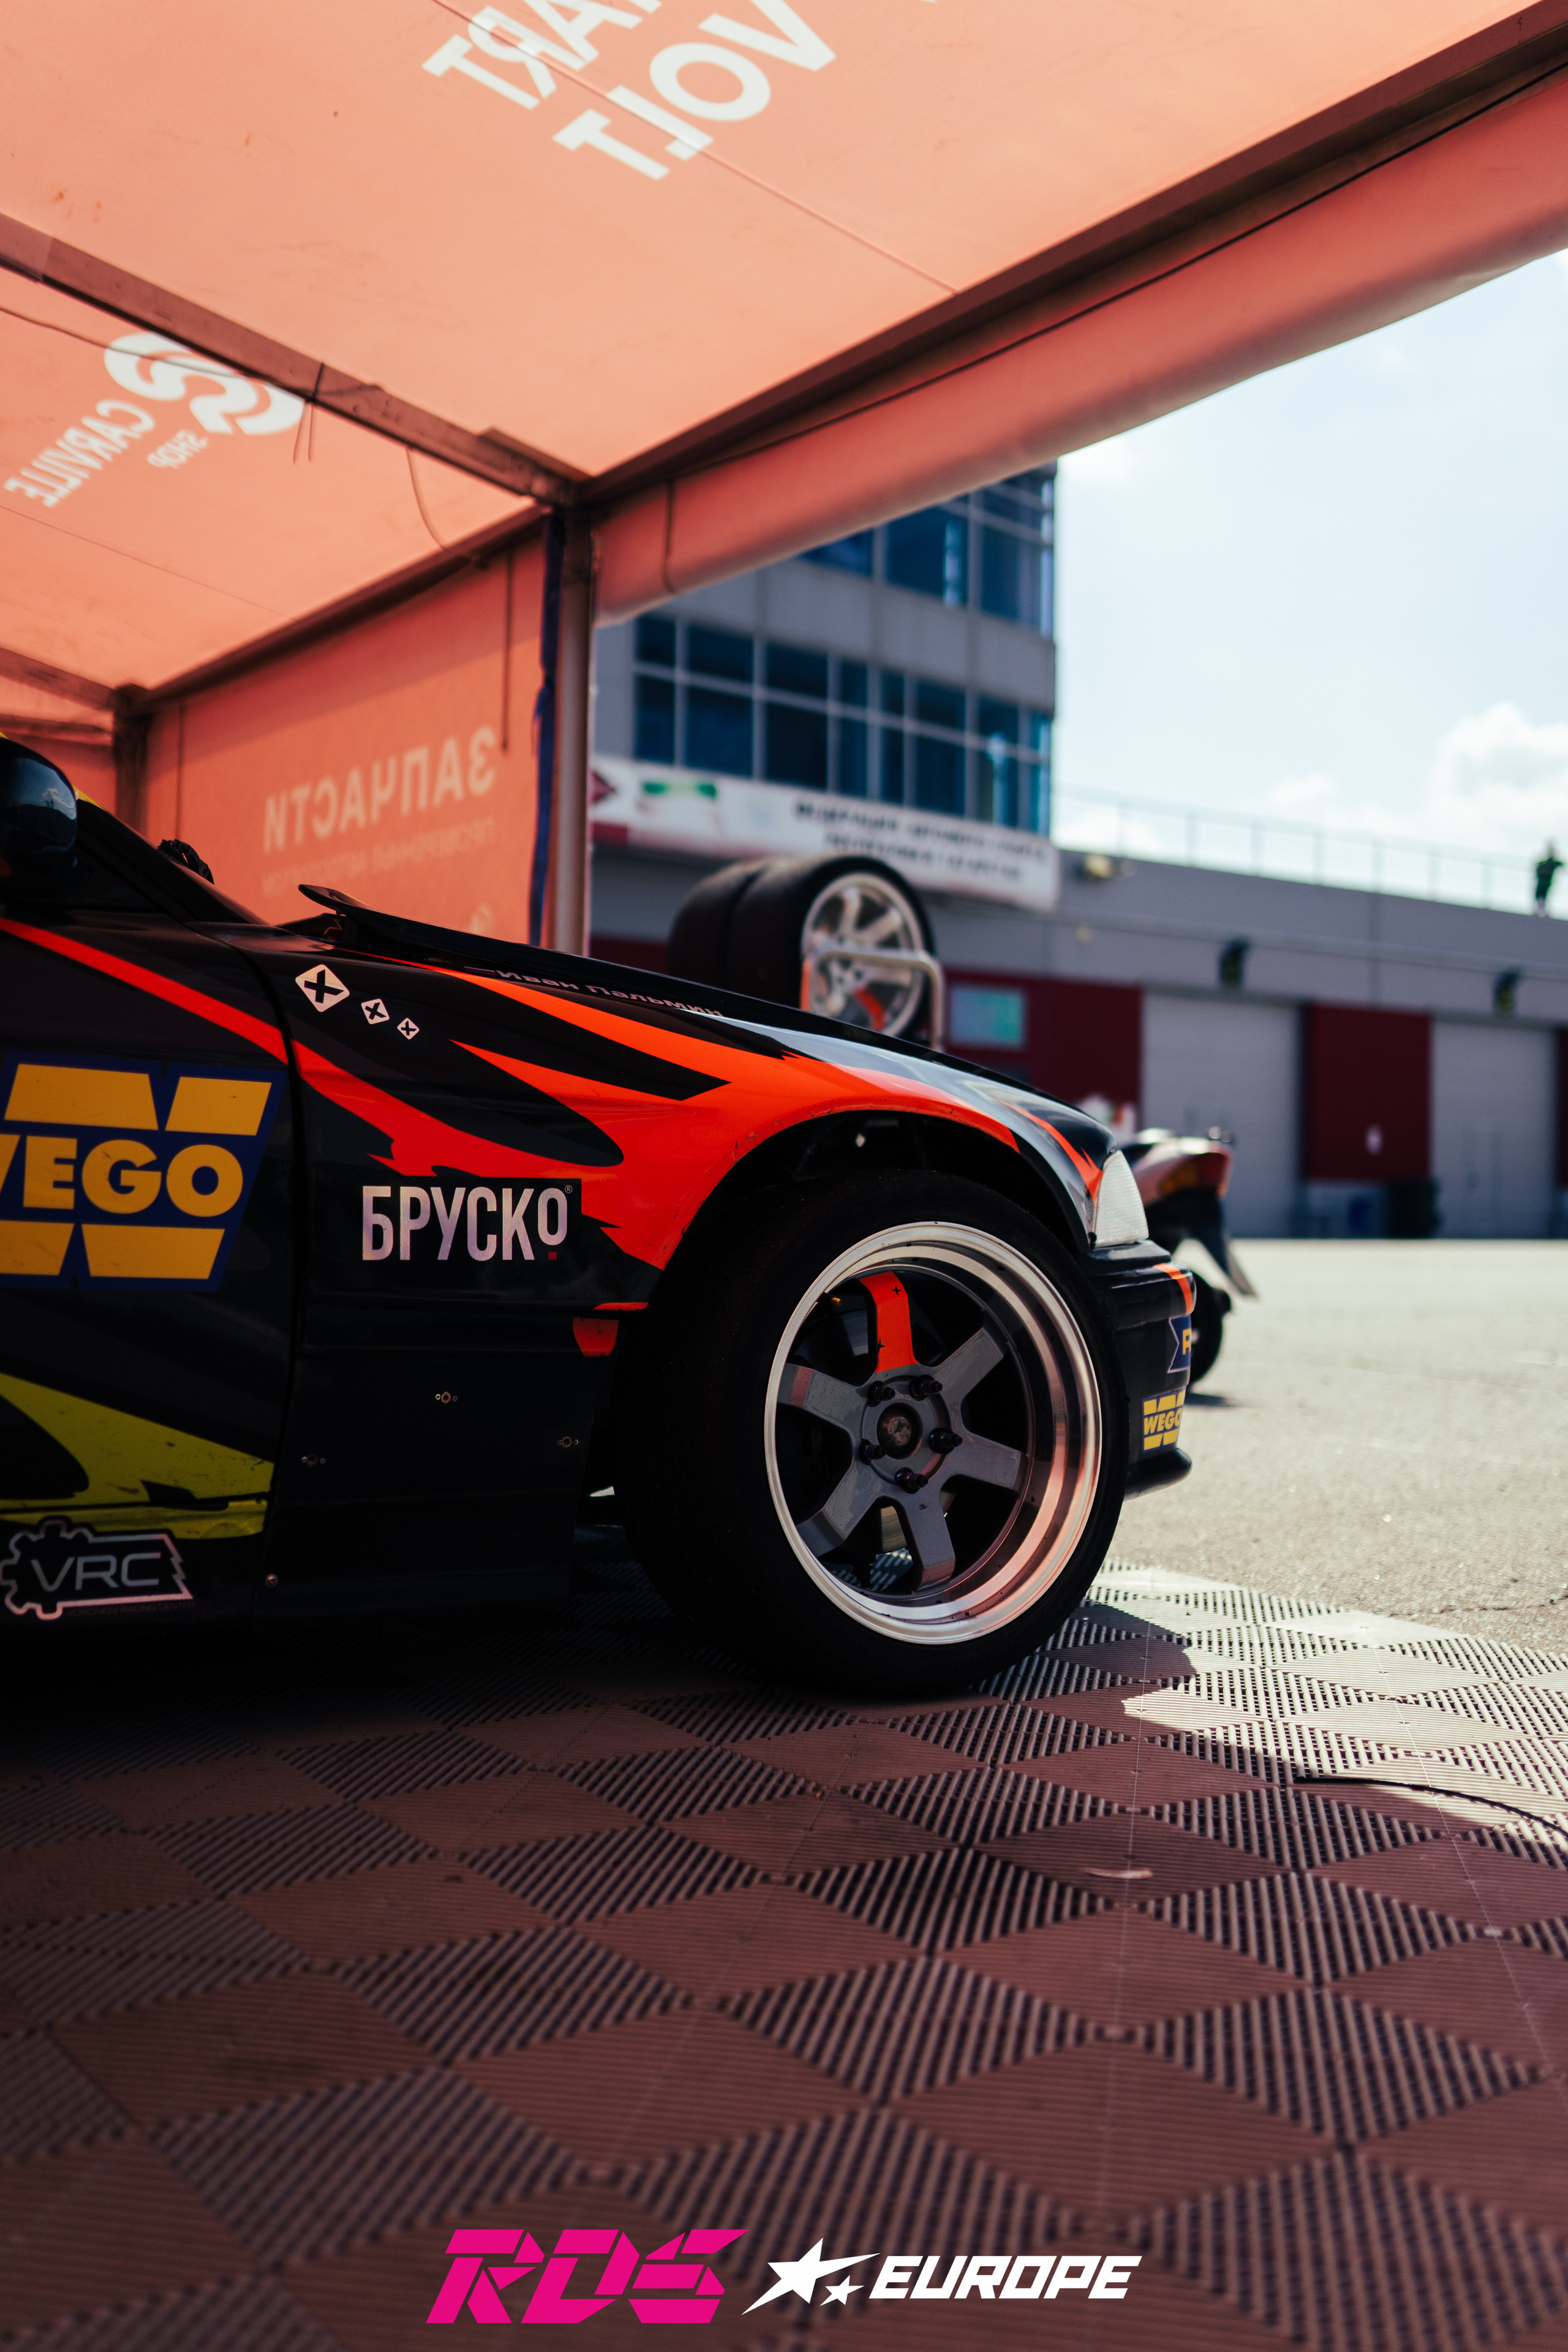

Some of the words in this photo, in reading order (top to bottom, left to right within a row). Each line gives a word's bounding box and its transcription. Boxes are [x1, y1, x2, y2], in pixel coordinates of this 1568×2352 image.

[496, 970, 579, 990] Иван
[584, 984, 725, 1017] Пальмин
[0, 1133, 244, 1218] EGO
[31, 1552, 161, 1593] VRC
